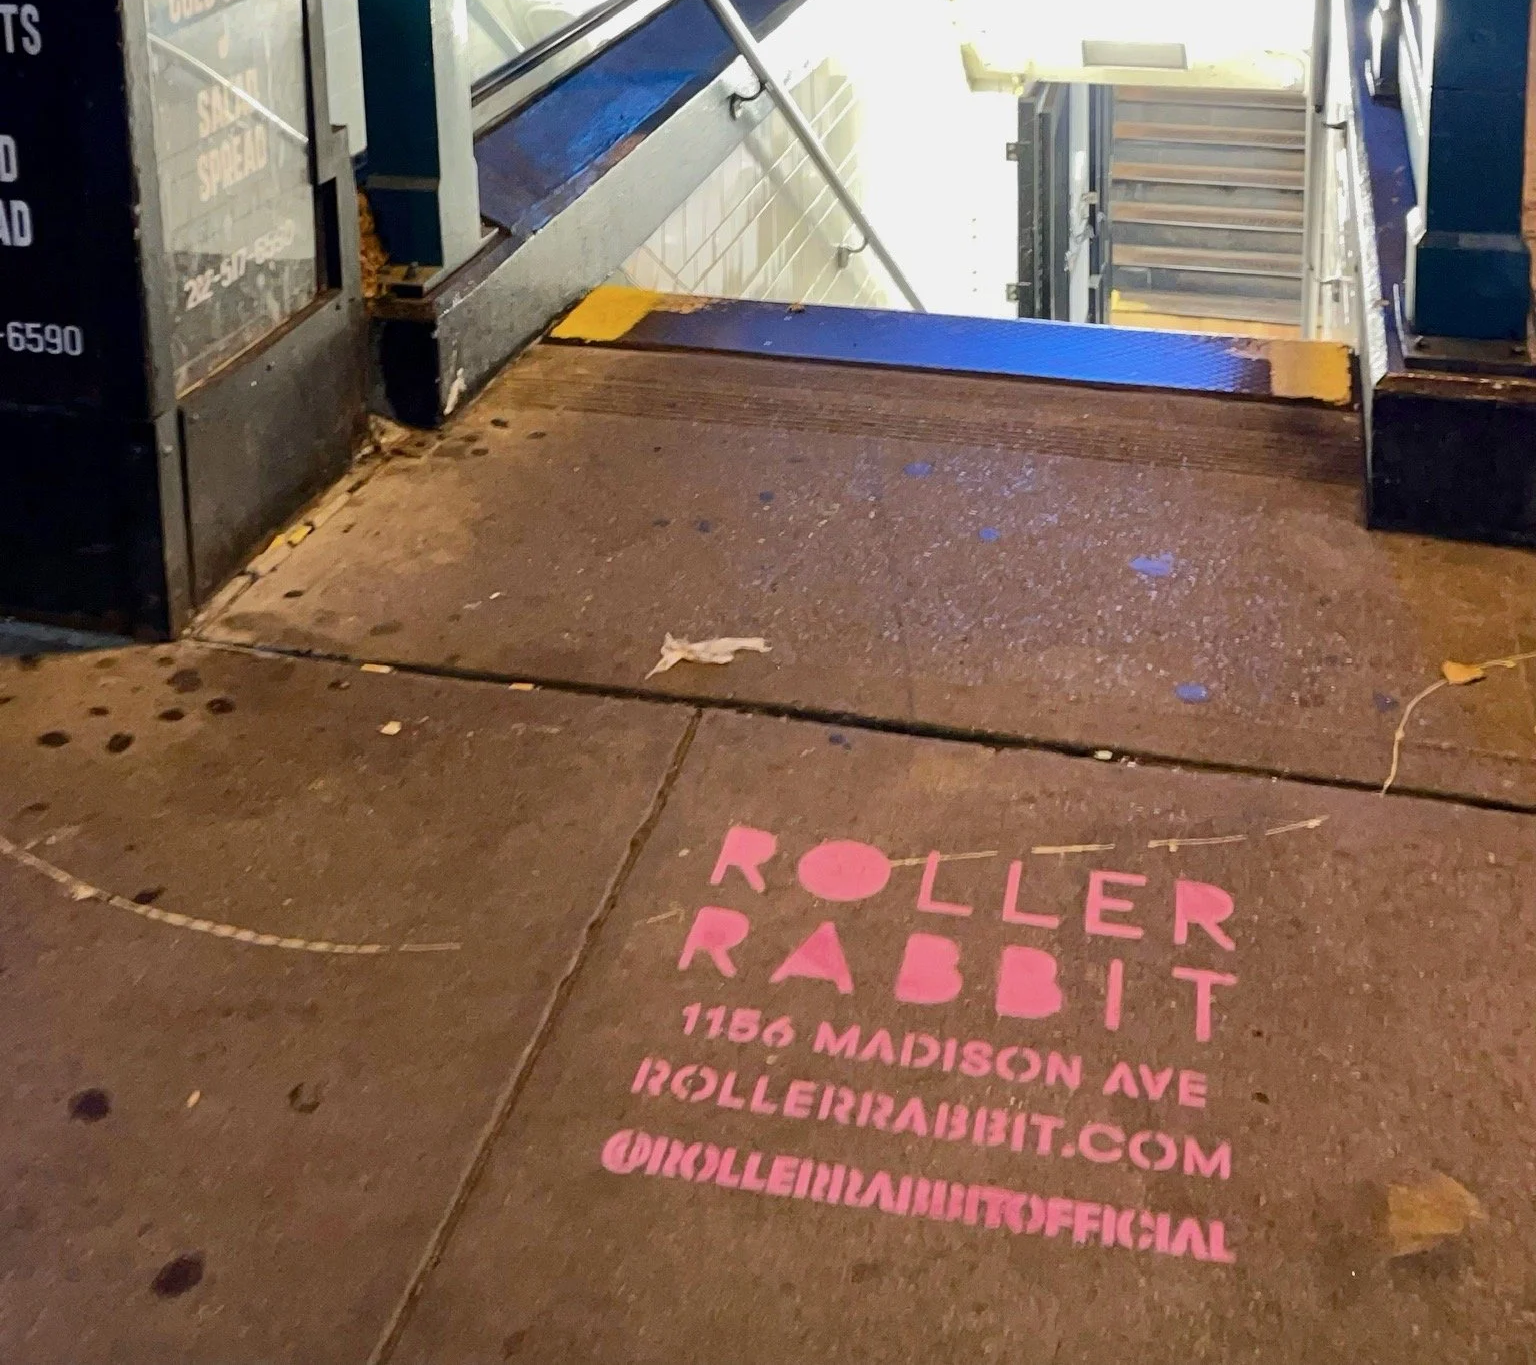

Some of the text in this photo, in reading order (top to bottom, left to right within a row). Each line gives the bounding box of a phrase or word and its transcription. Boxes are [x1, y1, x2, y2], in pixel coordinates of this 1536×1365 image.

[196, 124, 269, 202] SPREAD
[710, 825, 1235, 951] ROLLER
[678, 905, 1238, 1042] RABBIT
[681, 1002, 1208, 1108] 1156 MADISON AVE
[630, 1056, 1232, 1180] ROLLERRABBIT.COM
[601, 1128, 1236, 1263] @ROLLERRABBITOFFICIAL
